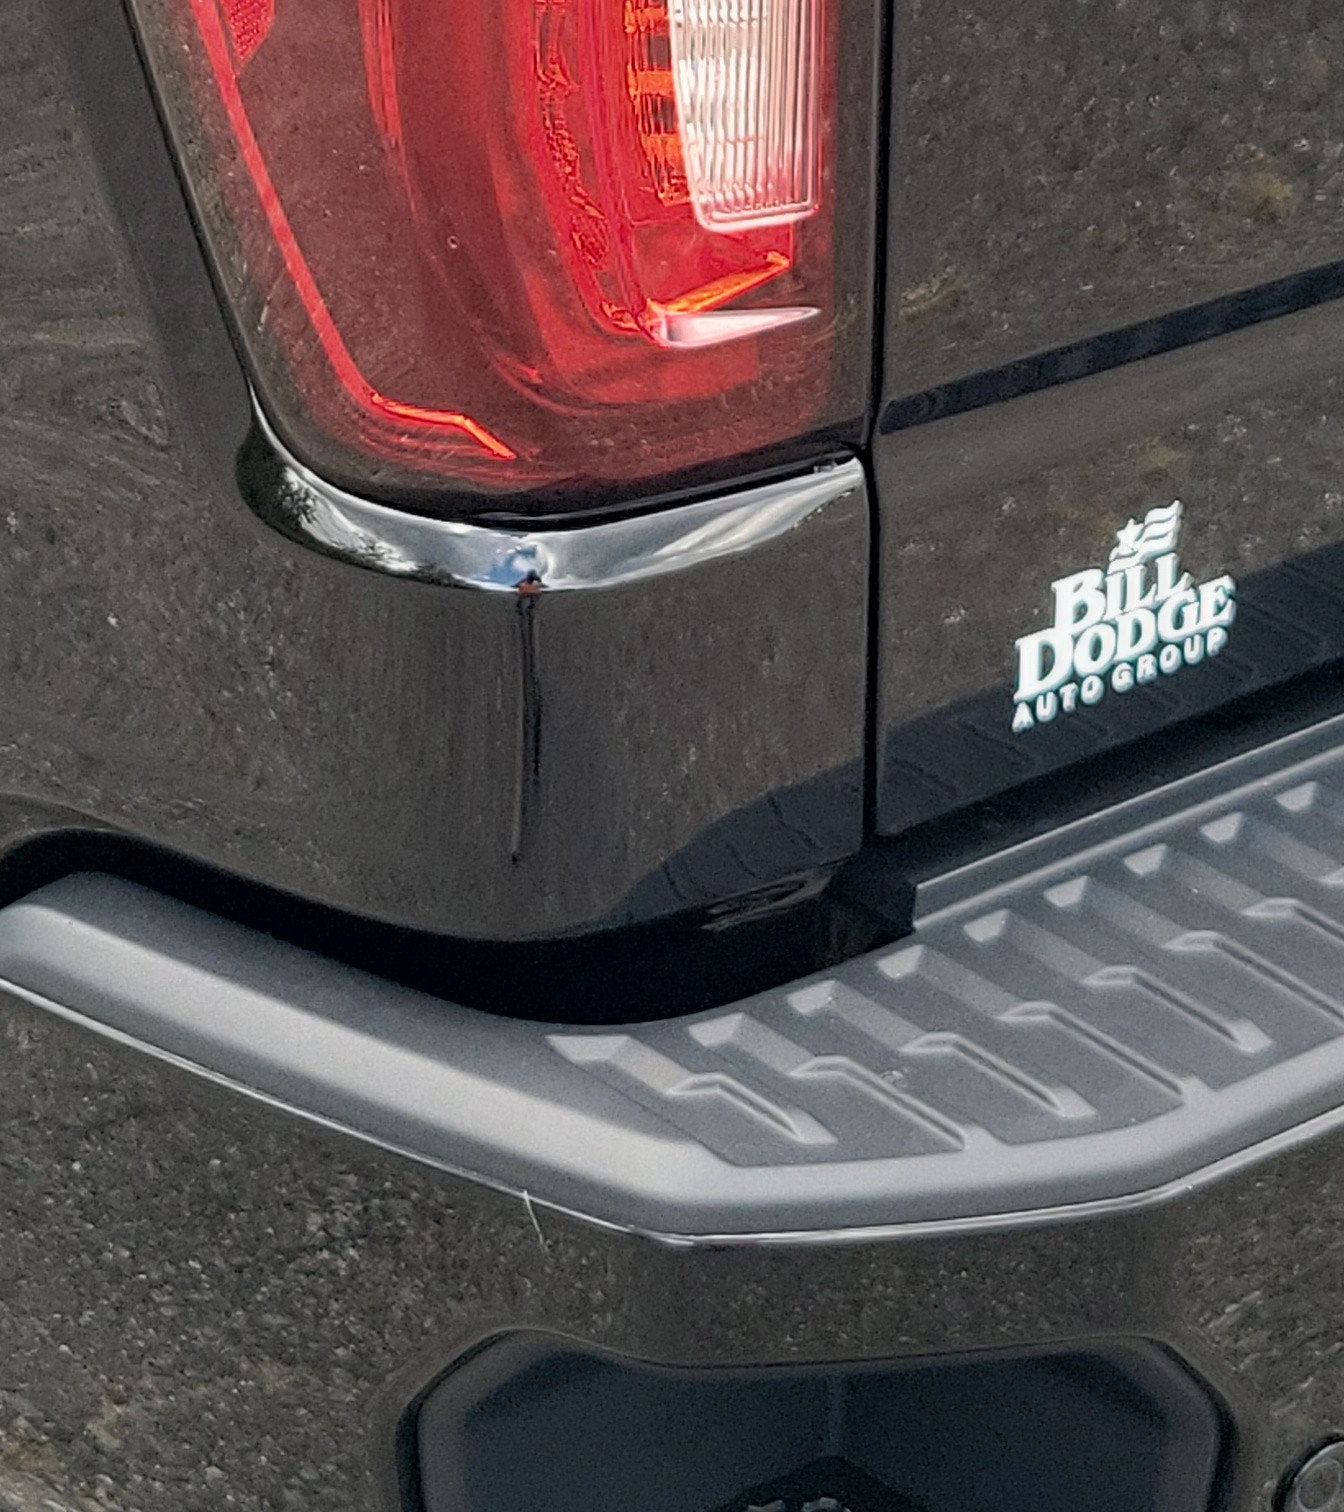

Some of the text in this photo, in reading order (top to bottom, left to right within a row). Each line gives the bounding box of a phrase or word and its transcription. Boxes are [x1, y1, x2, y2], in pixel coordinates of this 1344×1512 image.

[1013, 575, 1237, 704] DODGE
[1051, 552, 1195, 635] BILL
[1011, 627, 1229, 733] AUTO GROUP
